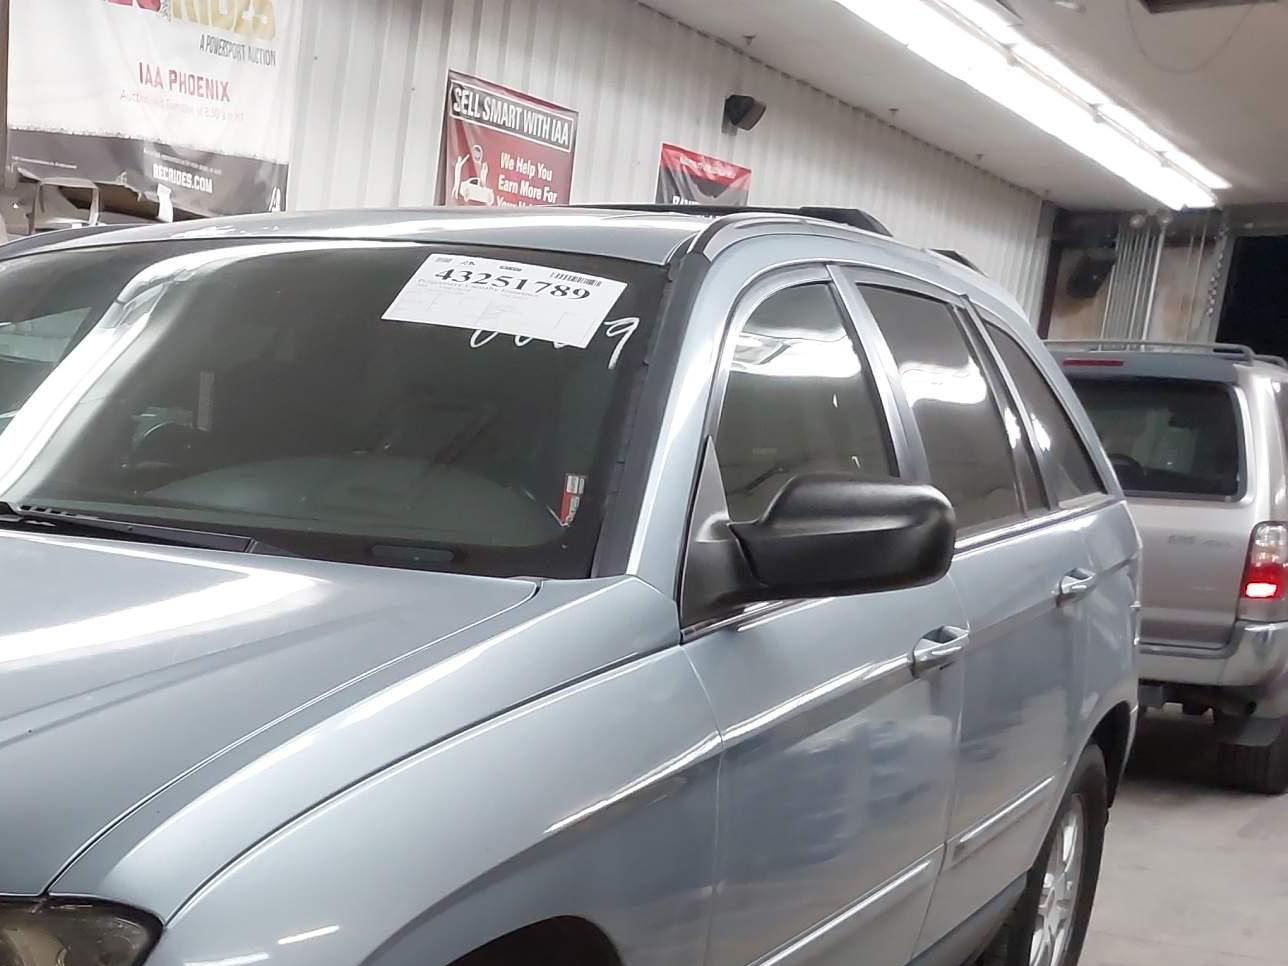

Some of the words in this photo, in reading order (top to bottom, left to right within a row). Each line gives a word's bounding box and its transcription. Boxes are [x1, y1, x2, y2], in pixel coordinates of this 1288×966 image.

[247, 45, 276, 66] AUCTION
[139, 62, 164, 90] IAA
[168, 69, 231, 103] PHOENIX
[453, 87, 481, 118] SELL
[482, 96, 523, 130] SMART
[523, 109, 551, 140] WITH
[551, 119, 569, 146] IAA
[153, 164, 213, 193] RECRIDES.COM
[500, 152, 514, 169] We
[516, 157, 536, 178] Help
[537, 163, 552, 181] You
[498, 174, 518, 194] Earn
[520, 180, 542, 199] More
[543, 187, 557, 203] For
[434, 268, 591, 300] 43251789
